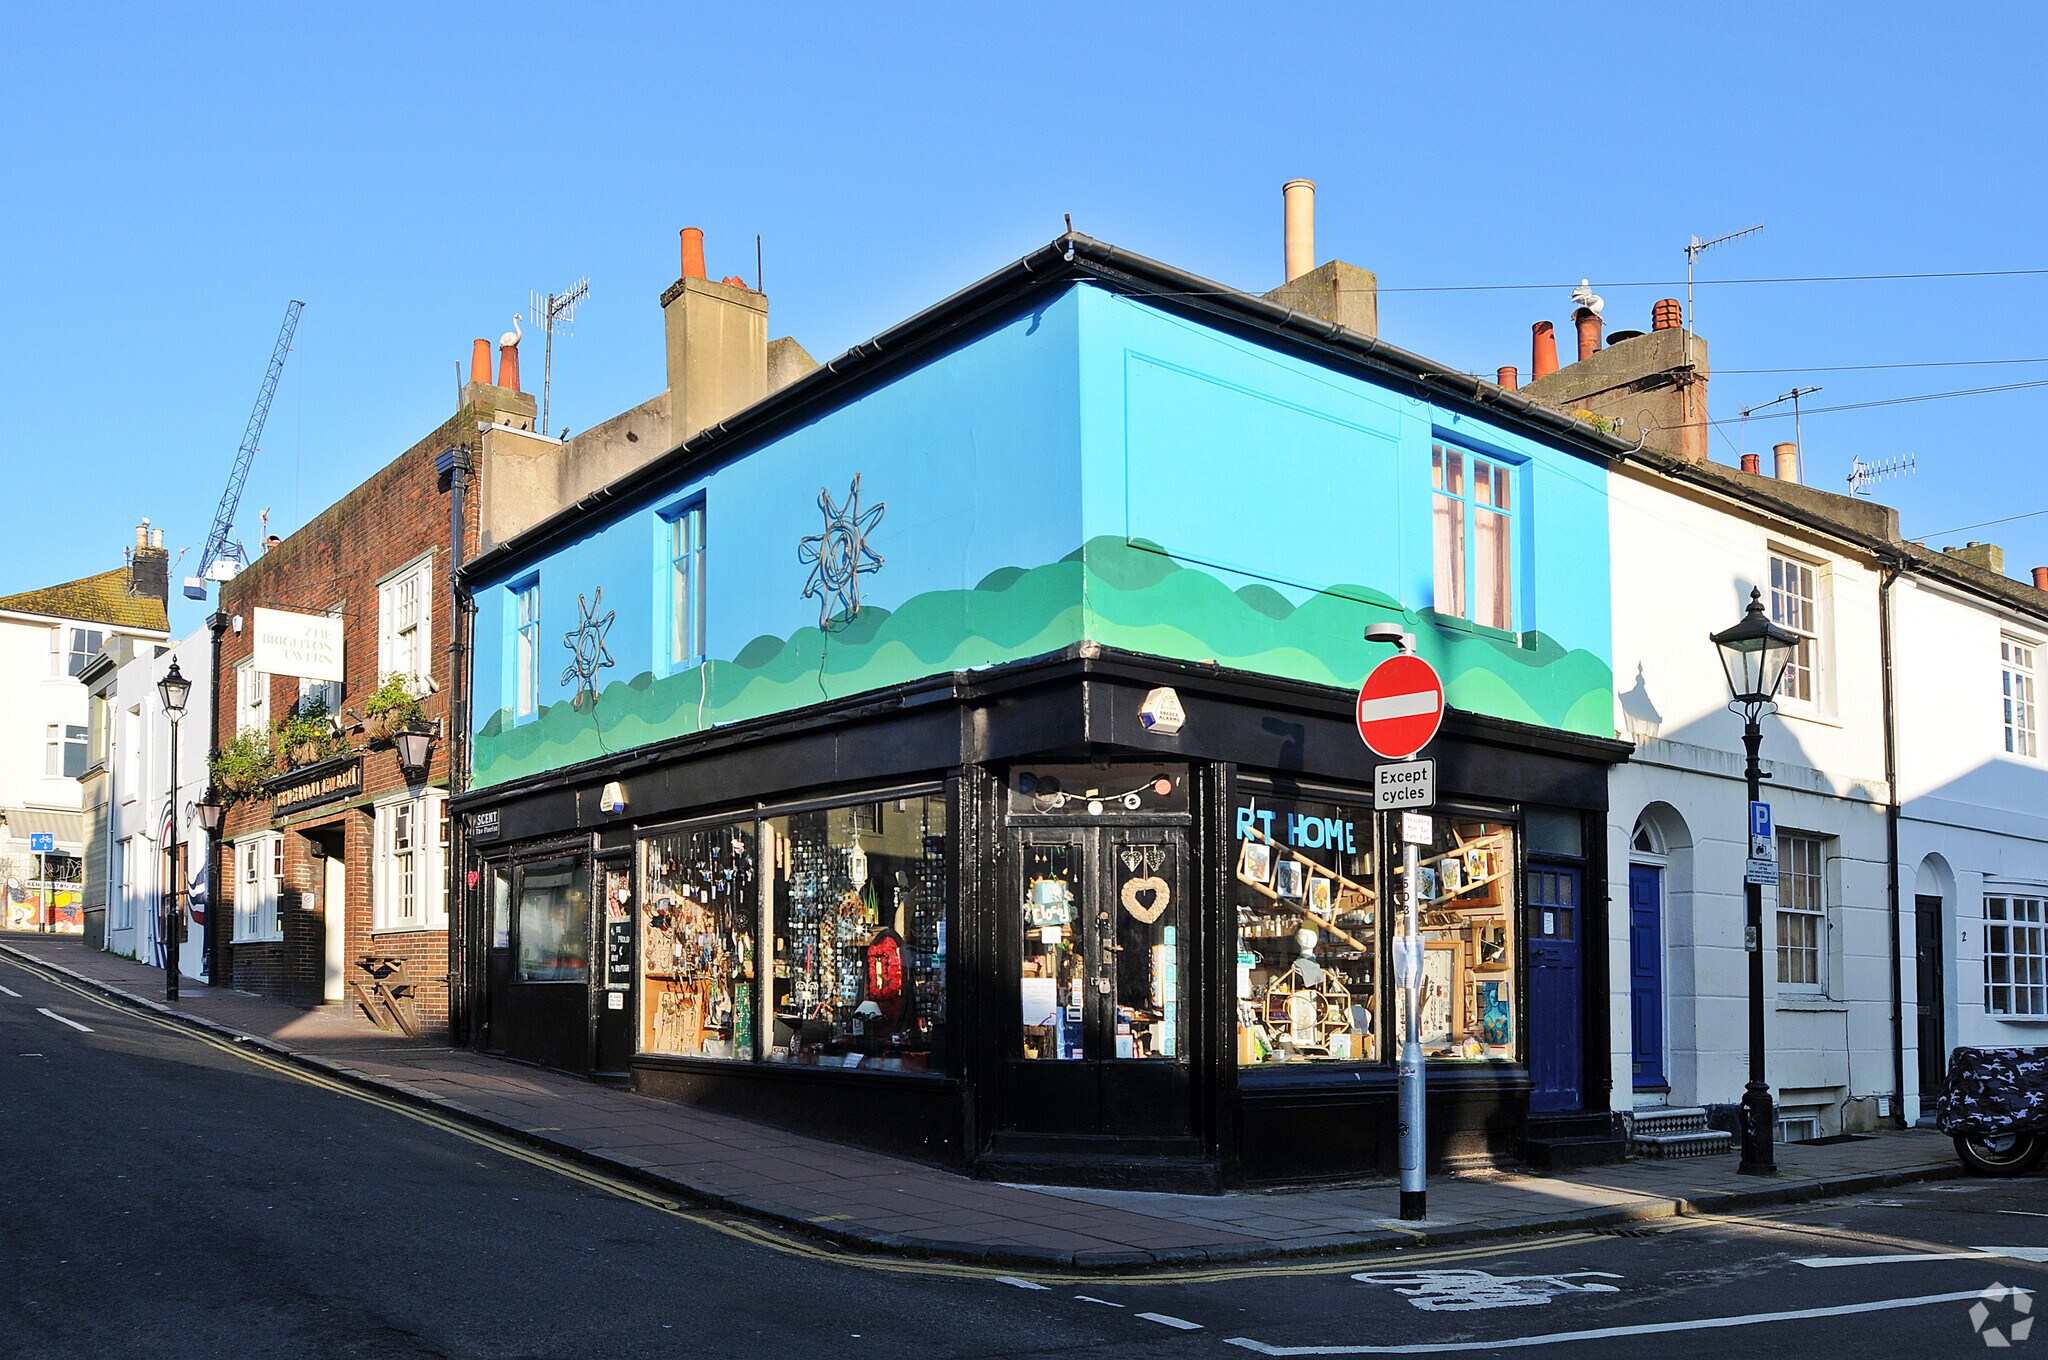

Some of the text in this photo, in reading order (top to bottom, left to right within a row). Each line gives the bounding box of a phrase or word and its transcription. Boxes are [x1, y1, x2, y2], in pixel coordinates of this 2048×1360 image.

[263, 633, 333, 652] BRIGHTON
[281, 649, 333, 664] TAVERN
[1381, 768, 1427, 784] Except
[1382, 787, 1425, 804] cycles
[477, 811, 498, 826] SCENT
[1756, 806, 1769, 833] P
[1288, 813, 1357, 855] HOME
[1961, 931, 1967, 942] 2
